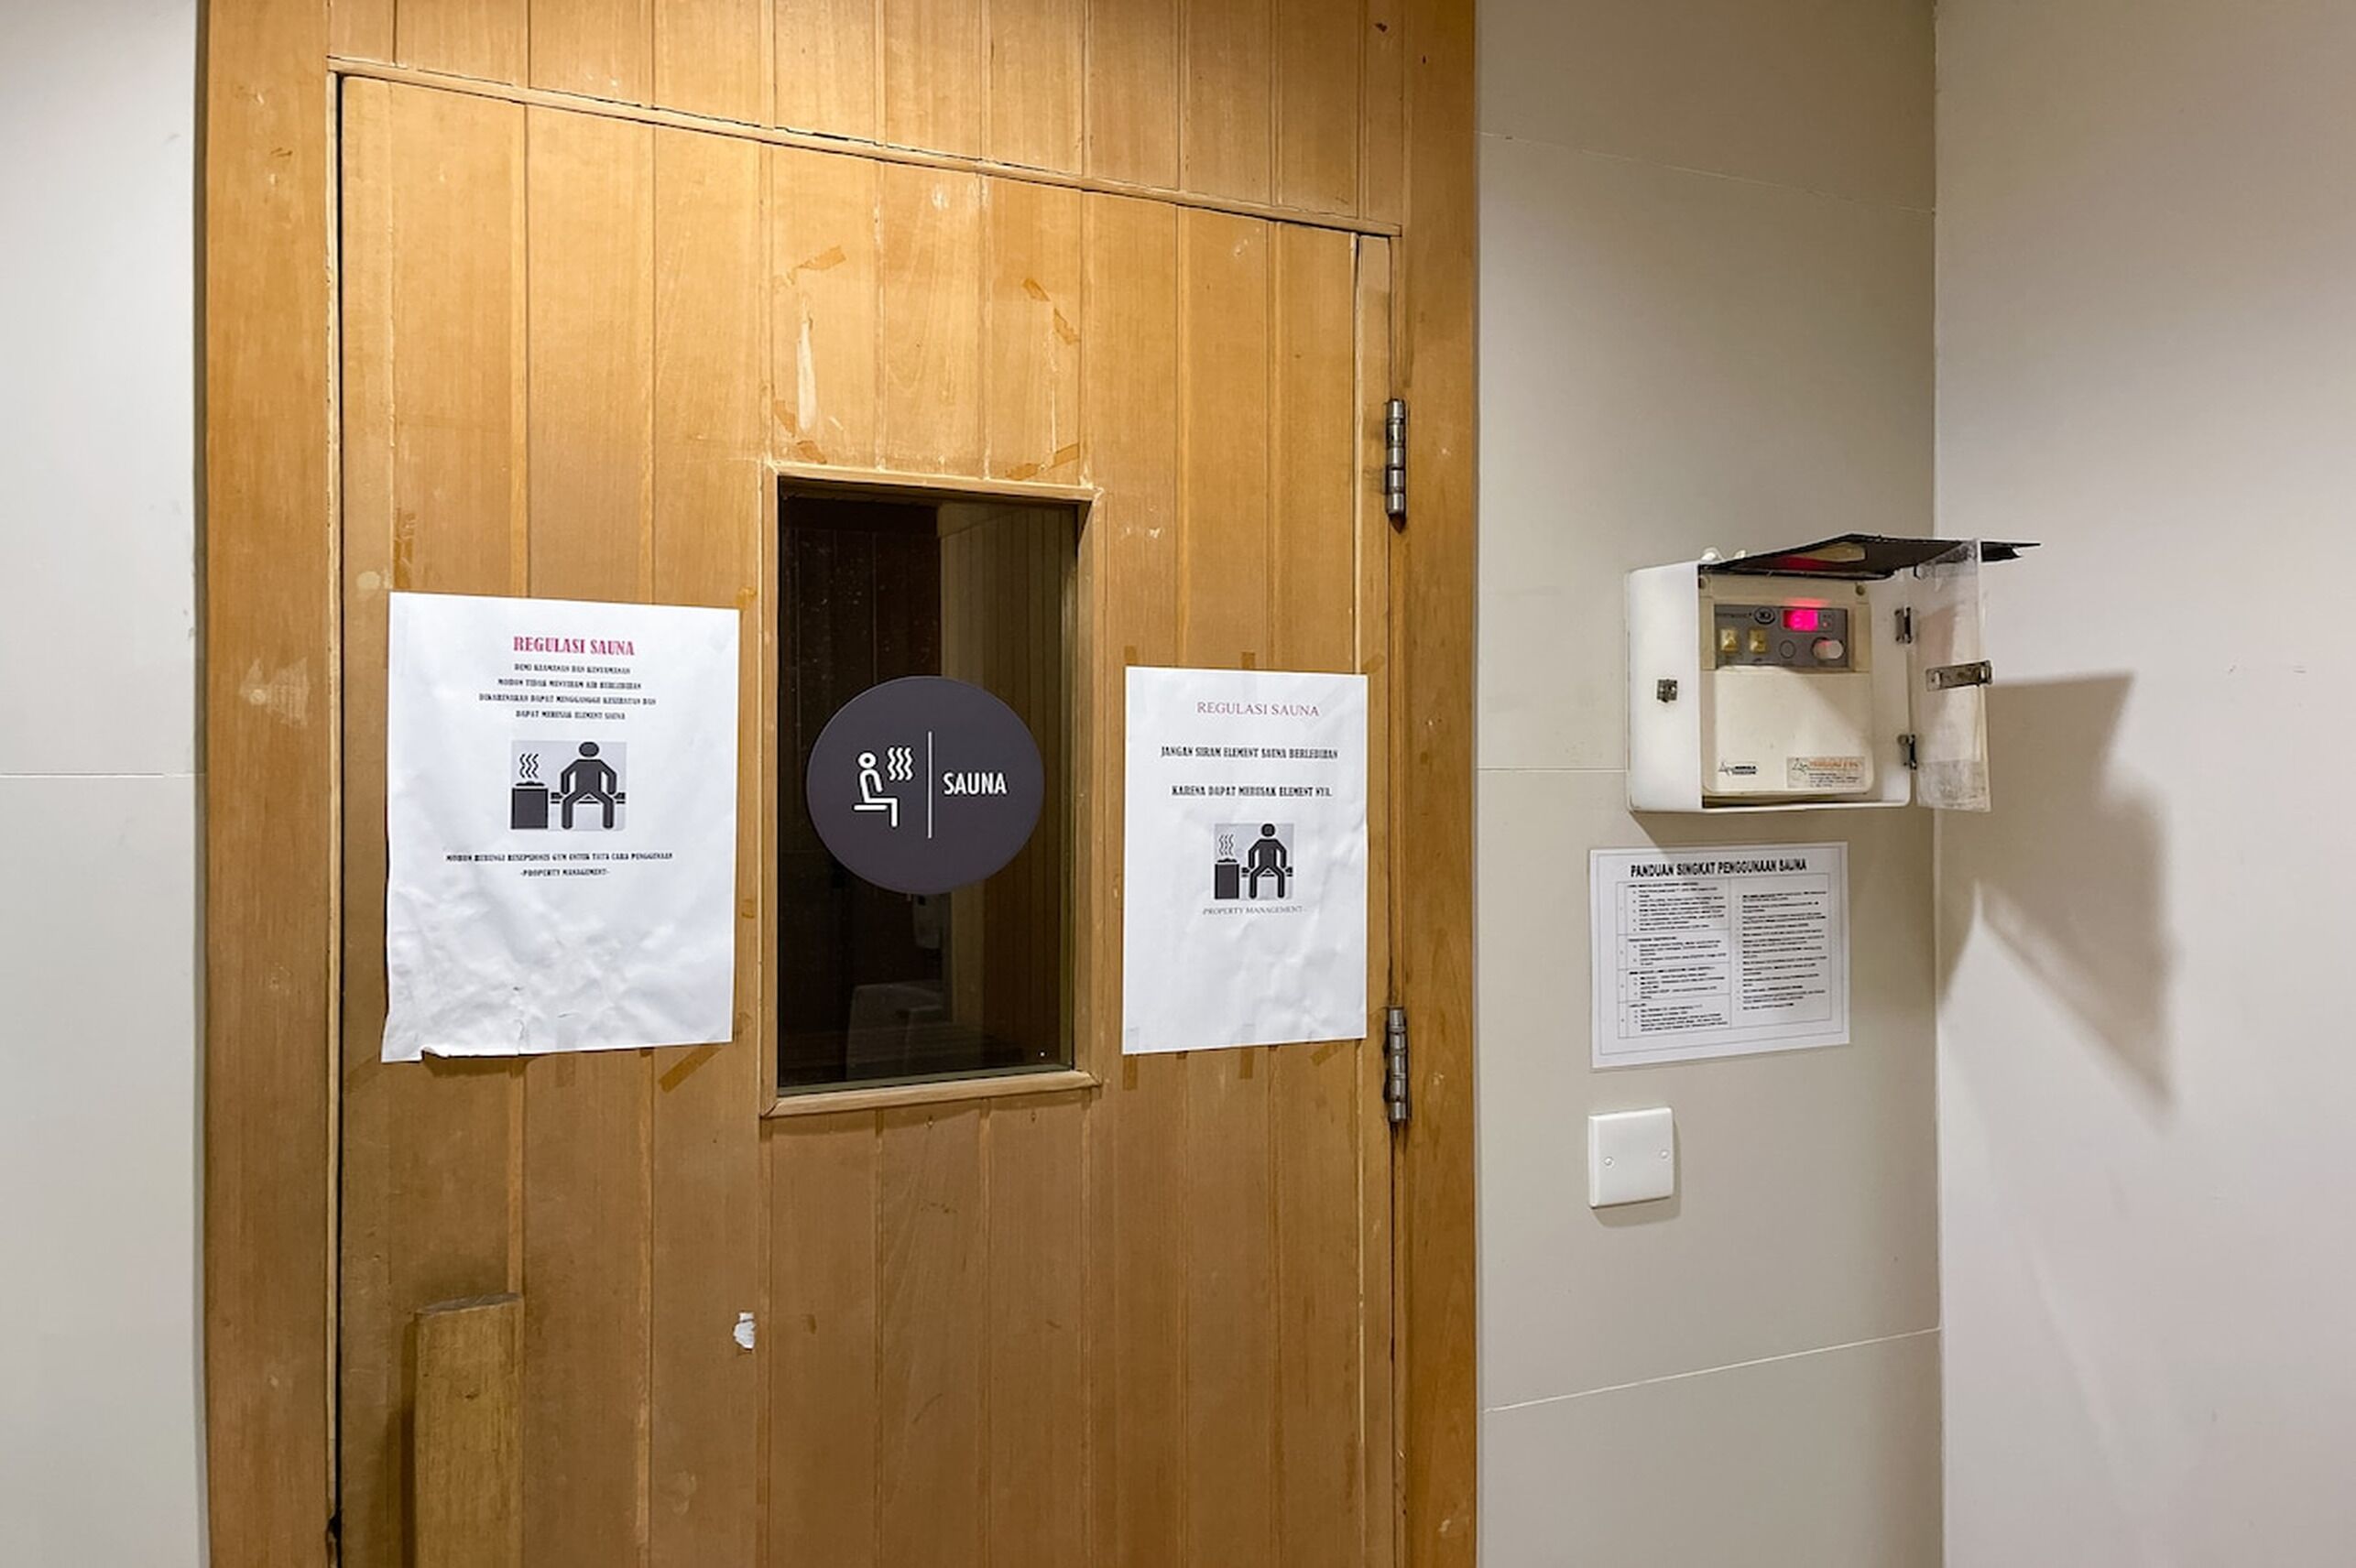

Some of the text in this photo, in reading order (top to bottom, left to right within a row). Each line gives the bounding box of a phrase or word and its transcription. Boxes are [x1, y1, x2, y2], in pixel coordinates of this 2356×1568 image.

[513, 636, 635, 656] REGULASI SAUNA
[1197, 701, 1320, 717] REGULASI SAUNA
[1161, 746, 1338, 759] JANGAN SIRAM ELEMENT SAUNA BERLEBIHAN
[943, 772, 1008, 795] SAUNA
[1172, 785, 1205, 796] KARENA
[1208, 786, 1236, 797] DAPAT
[1238, 786, 1277, 797] MERUSAK
[1279, 787, 1313, 797] ELEMENT
[1631, 858, 1807, 877] PANDUAN SINGKAT PENGGUNAAN SAUNA
